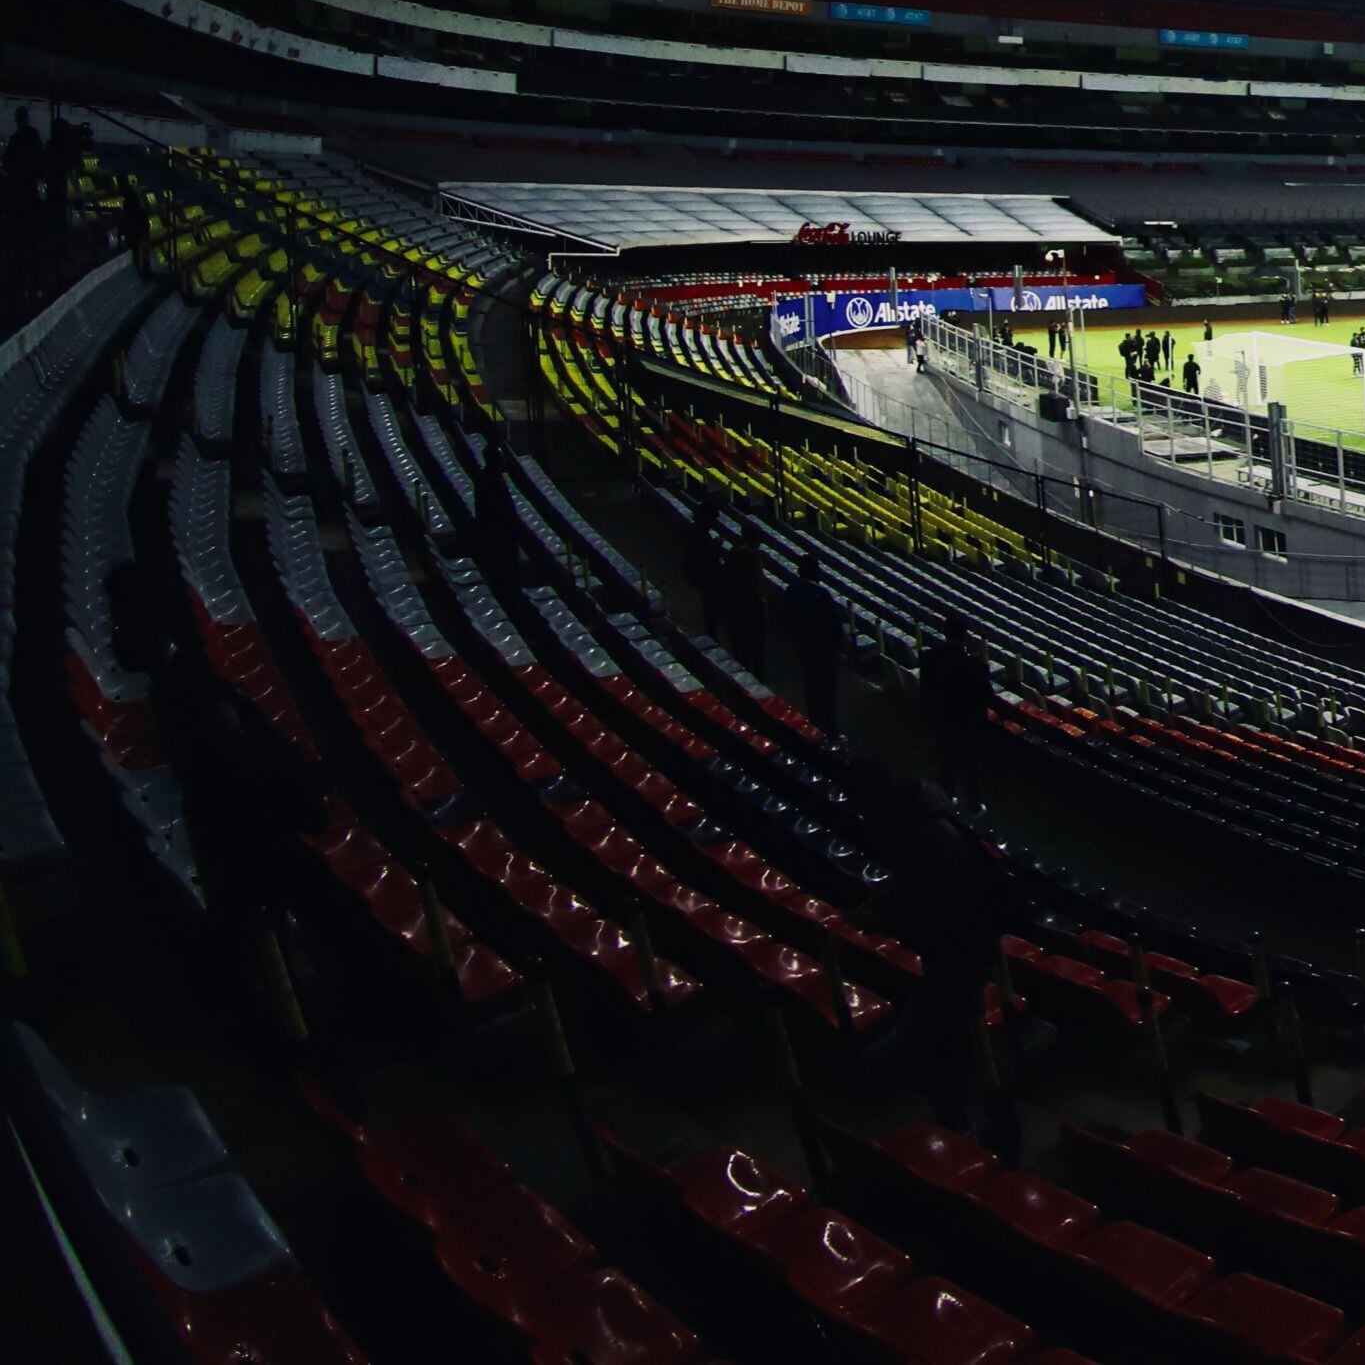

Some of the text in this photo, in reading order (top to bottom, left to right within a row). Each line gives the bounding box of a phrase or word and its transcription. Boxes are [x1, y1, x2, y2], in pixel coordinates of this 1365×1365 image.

[771, 0, 806, 12] DEPOT
[850, 231, 902, 245] LOUNGE
[1044, 294, 1109, 311] Allstate
